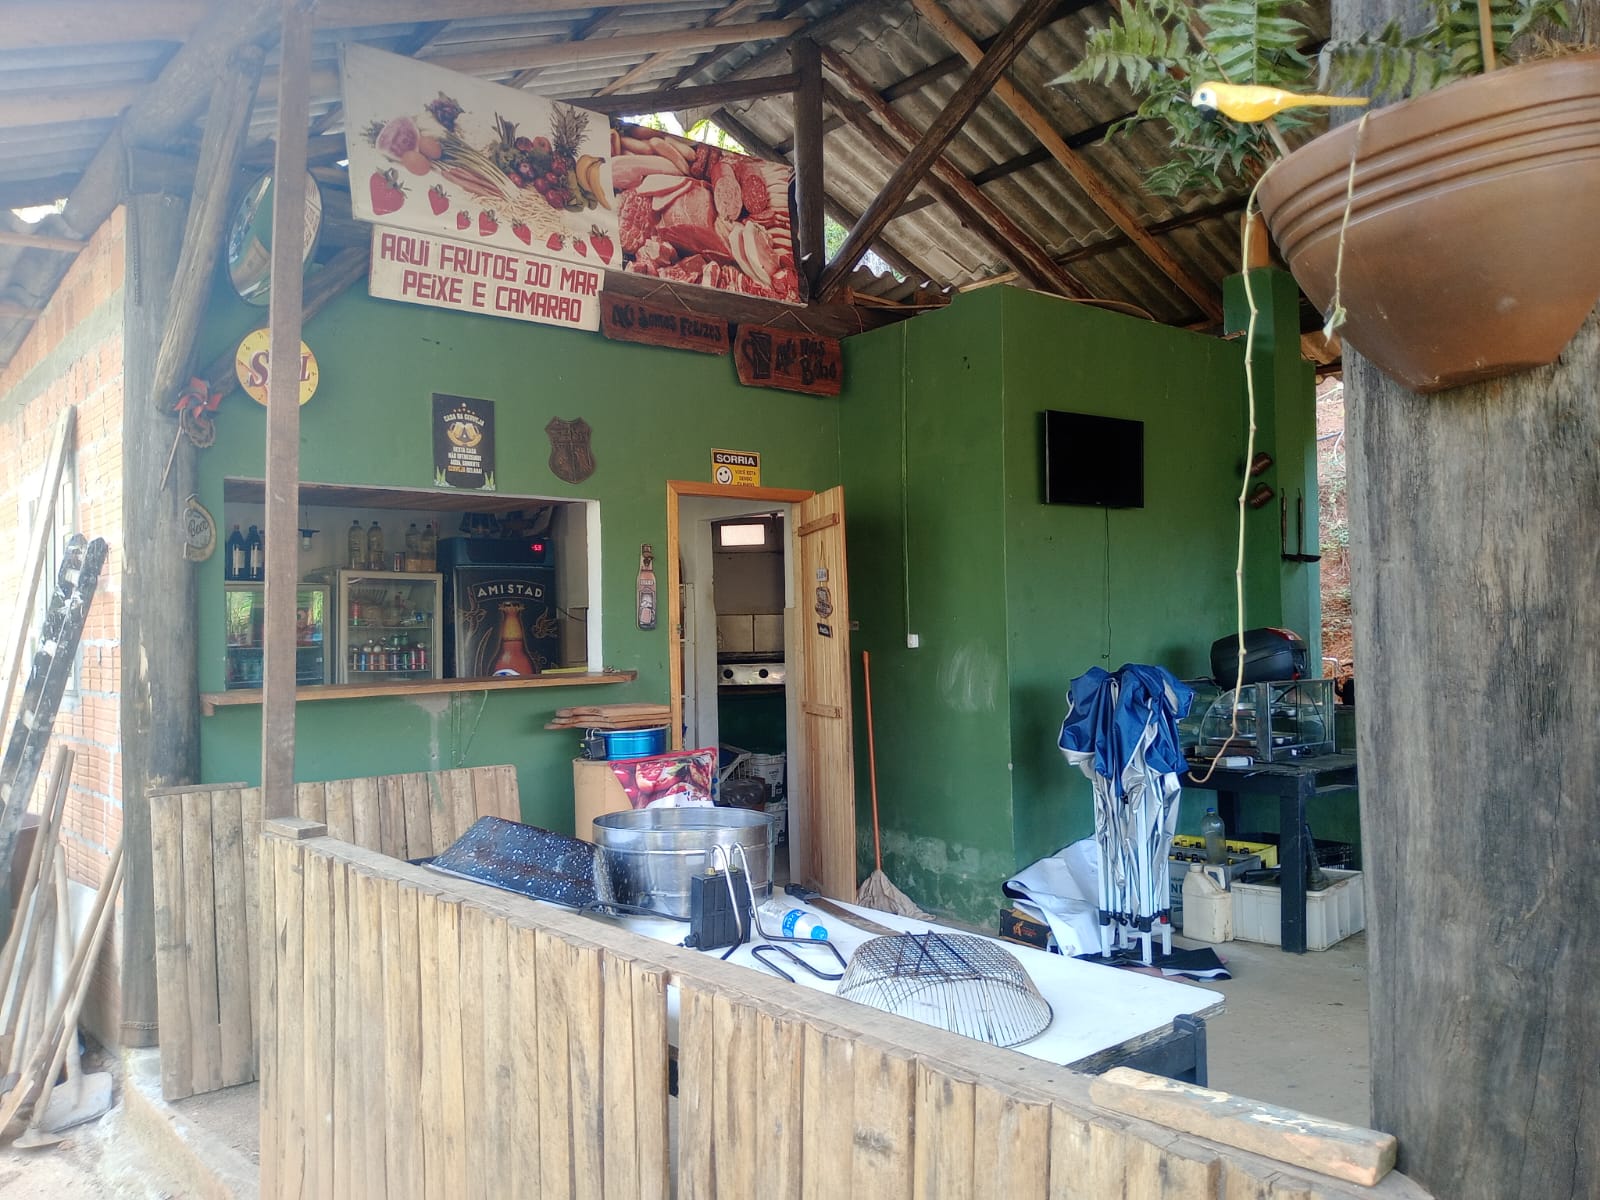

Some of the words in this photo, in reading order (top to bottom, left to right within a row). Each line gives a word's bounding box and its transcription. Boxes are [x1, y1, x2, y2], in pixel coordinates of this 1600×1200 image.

[381, 233, 430, 267] AQUI
[439, 244, 519, 283] FRUTOS
[524, 260, 552, 288] DO
[559, 267, 599, 297] MAR
[402, 269, 463, 304] PEIXE
[472, 281, 486, 308] E
[717, 454, 755, 465] SORRIA
[477, 584, 544, 598] AMISTAD
